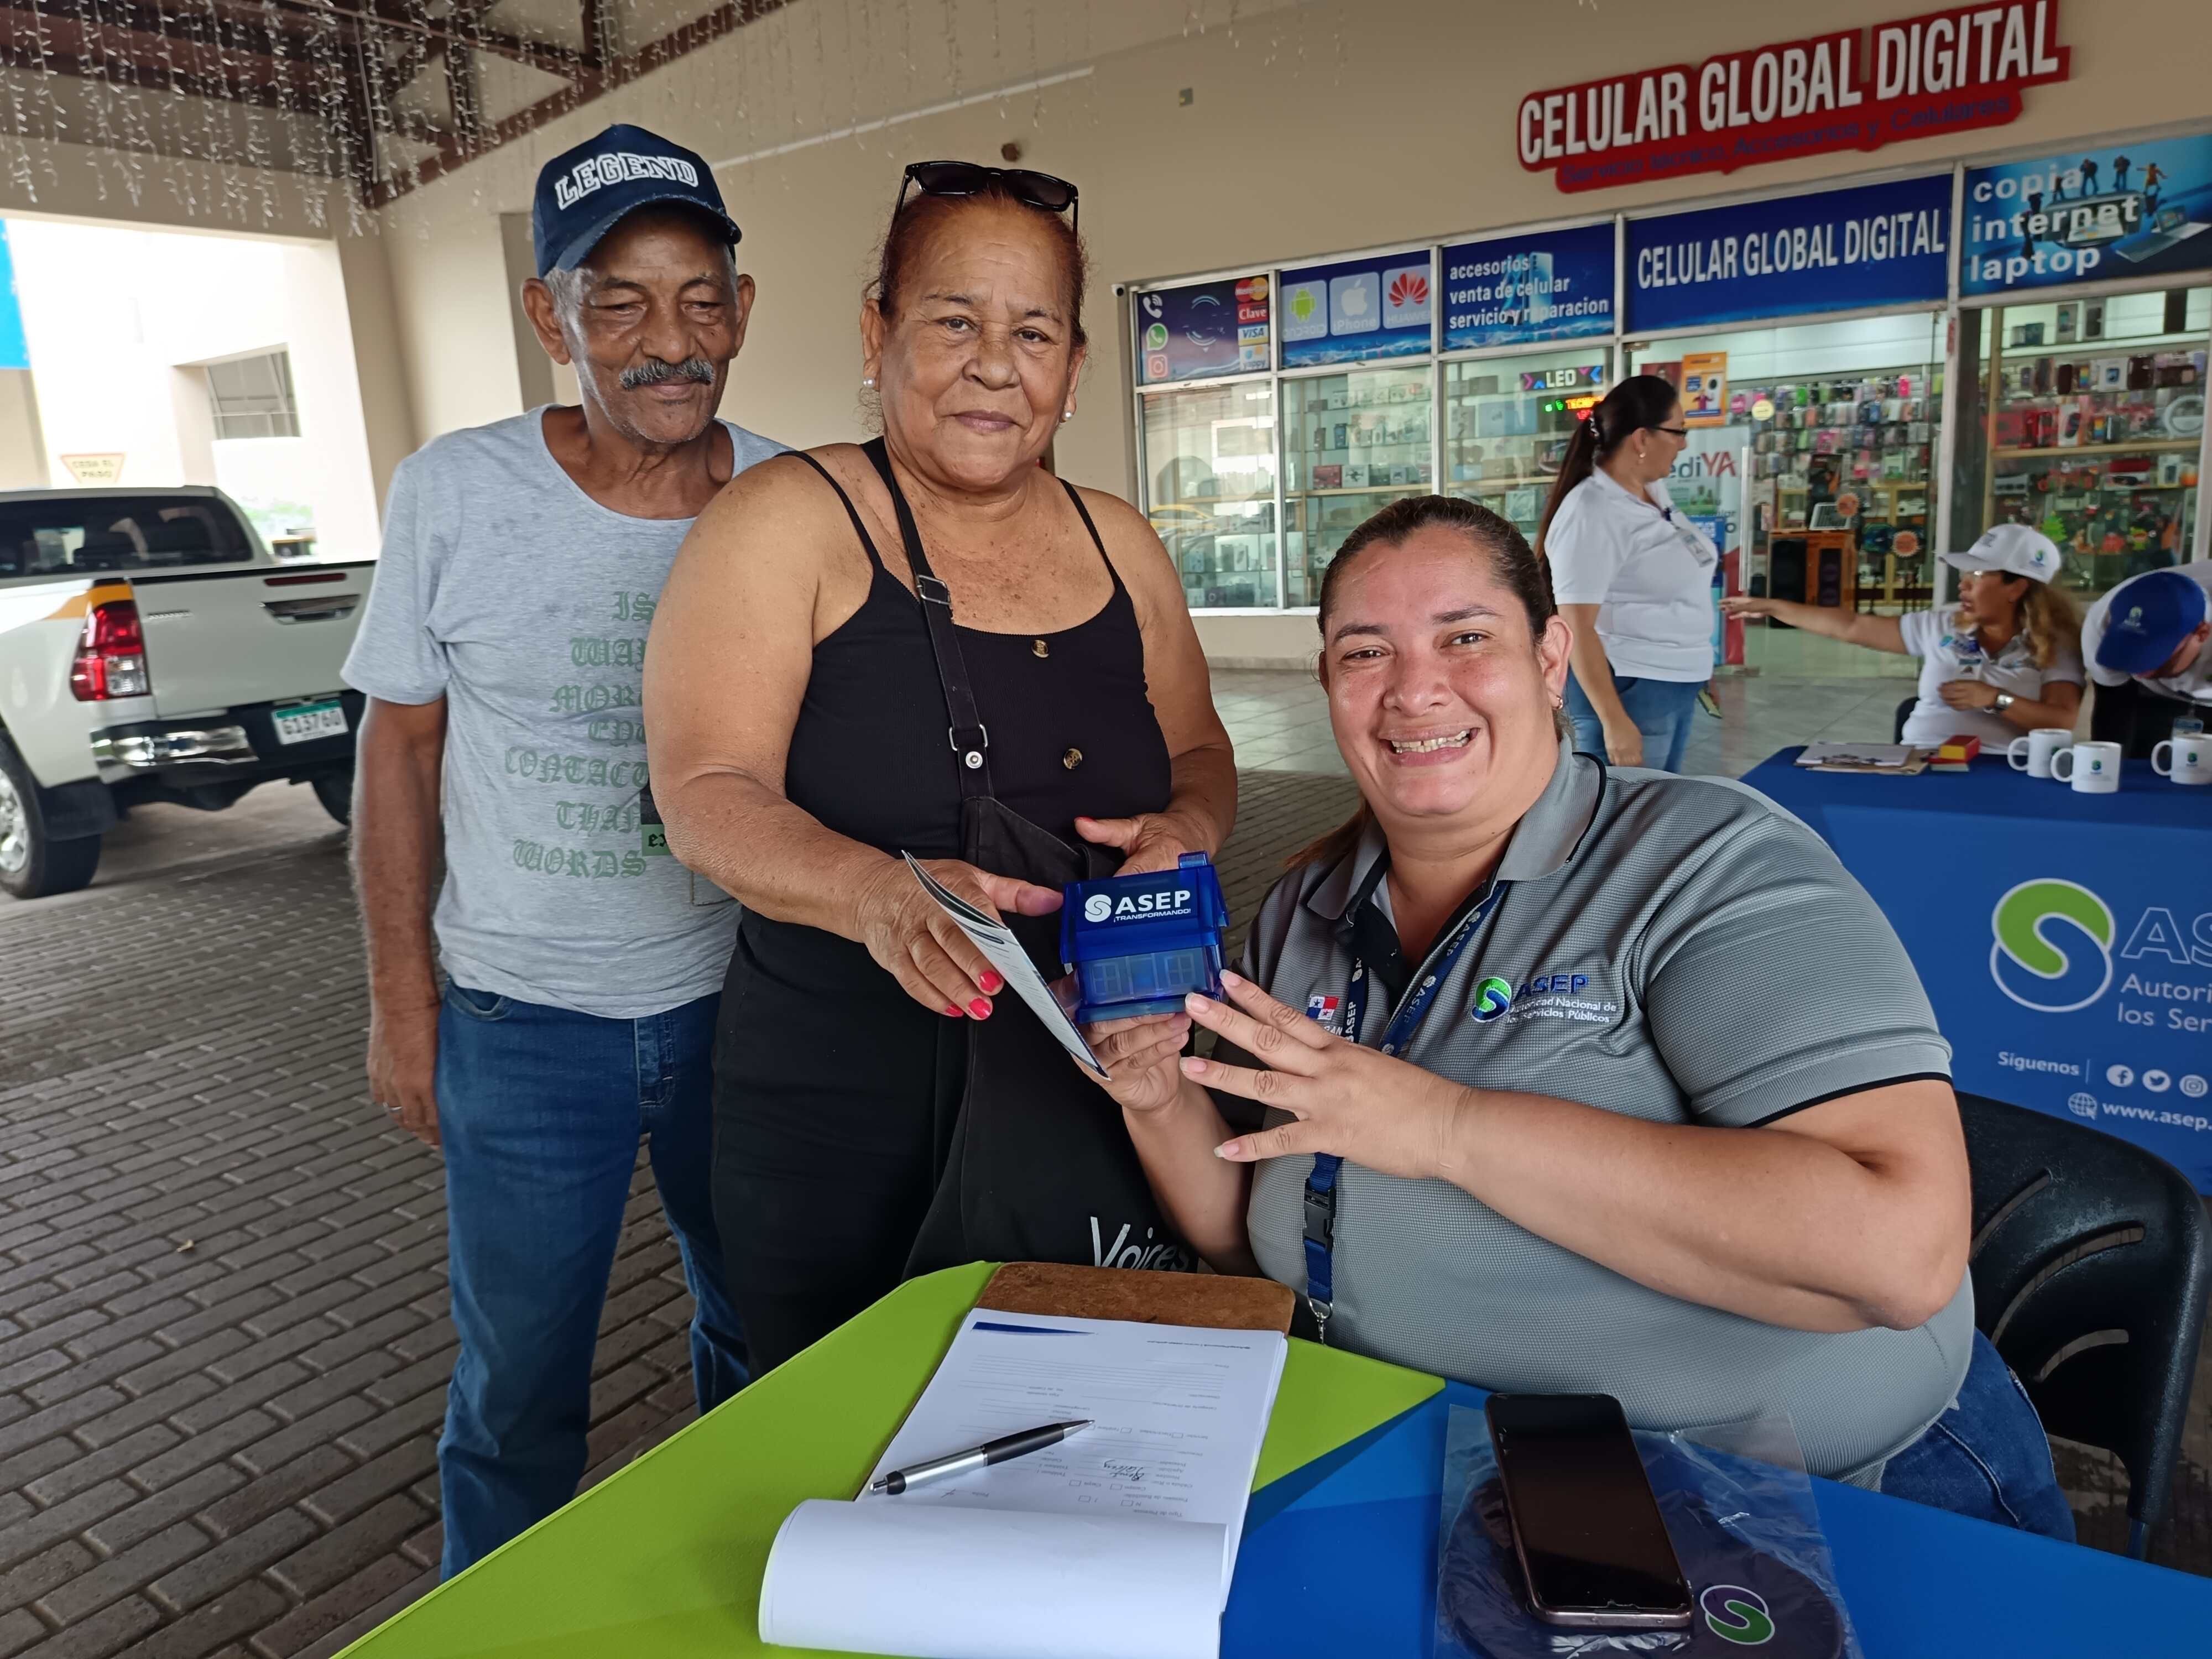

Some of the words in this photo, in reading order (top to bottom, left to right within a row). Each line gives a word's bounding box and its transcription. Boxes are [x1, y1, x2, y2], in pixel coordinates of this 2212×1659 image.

[1521, 72, 1687, 164] CELULAR
[1699, 37, 1863, 132] GLOBAL
[1876, 0, 2059, 101] DIGITAL
[1890, 96, 2011, 132] Celulares
[555, 152, 699, 211] LEGEND
[1973, 164, 2084, 203] copia
[1971, 196, 2140, 242] internet
[1637, 236, 1739, 289] CELULAR
[1743, 223, 1839, 276] GLOBAL
[1844, 208, 1945, 264] DIGITAL
[1449, 255, 1530, 280] accesorios
[1970, 247, 2100, 284] laptop
[1449, 285, 1491, 305] venta
[1494, 279, 1513, 299] de
[1516, 276, 1571, 297] celular
[1239, 307, 1267, 320] Clave
[1333, 317, 1377, 331] iPhone
[1449, 306, 1508, 330] servicio
[1509, 310, 1521, 326] y
[1523, 296, 1609, 324] reparacion
[1242, 327, 1265, 339] VISA
[1546, 369, 1576, 388] LED
[549, 684, 643, 713] MOR
[504, 746, 650, 789] CONTACT
[556, 801, 642, 836] THAN
[513, 838, 646, 878] WORDS
[1113, 908, 1192, 923] ¡TRANSFORMANDO!
[1115, 890, 1191, 915] ASEP
[1512, 974, 1589, 1002] ASEP
[2120, 973, 2212, 1003] Autori
[1345, 1001, 1357, 1035] ASEP
[1556, 998, 1601, 1011] Nacional
[1603, 1003, 1616, 1012] de
[1568, 1010, 1610, 1023] Públicos
[2117, 1002, 2154, 1026] los
[1090, 1216, 1189, 1271] Voices
